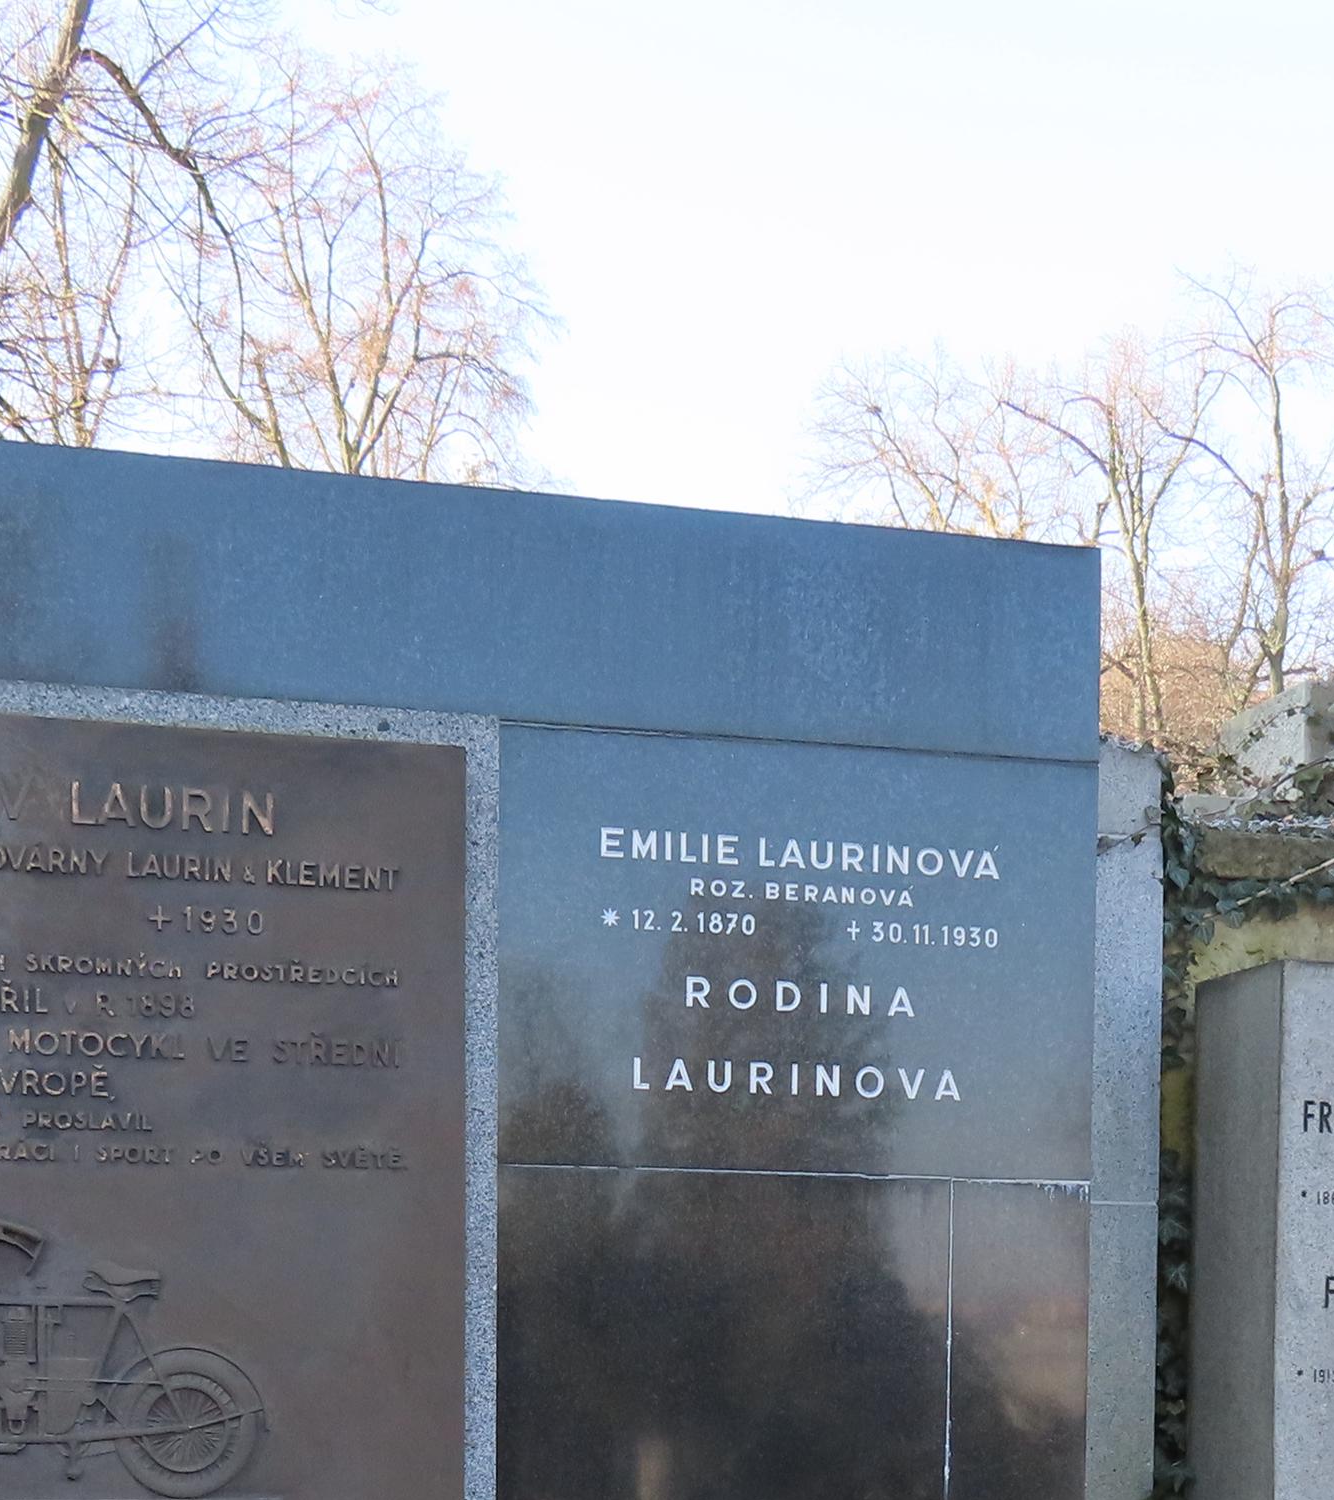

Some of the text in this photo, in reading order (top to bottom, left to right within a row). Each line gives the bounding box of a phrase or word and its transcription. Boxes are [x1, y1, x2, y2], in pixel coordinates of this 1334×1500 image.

[70, 779, 277, 836] LAURIN
[599, 826, 1002, 881] EMILIE LAURINOVÁ
[126, 850, 233, 883] LAURIN
[242, 864, 257, 885] &
[267, 858, 400, 891] KLEMENT
[689, 877, 915, 908] ROZ. BERANOVÁ
[182, 904, 265, 936] 1930
[696, 911, 756, 936] 1870
[205, 959, 400, 988] PROSTŘEDCÍCH
[127, 992, 197, 1019] 1898
[684, 975, 916, 1018] RODINA
[7, 1028, 186, 1060] MOTOCYKL
[207, 1037, 250, 1063] VE
[271, 1031, 402, 1069] STŘEDNÍ
[632, 1056, 962, 1102] LAURINOVA
[21, 1111, 154, 1132] PROSLAVIL
[93, 1144, 172, 1165] SPORT
[190, 1147, 223, 1165] PO
[240, 1139, 307, 1168] VŠEM
